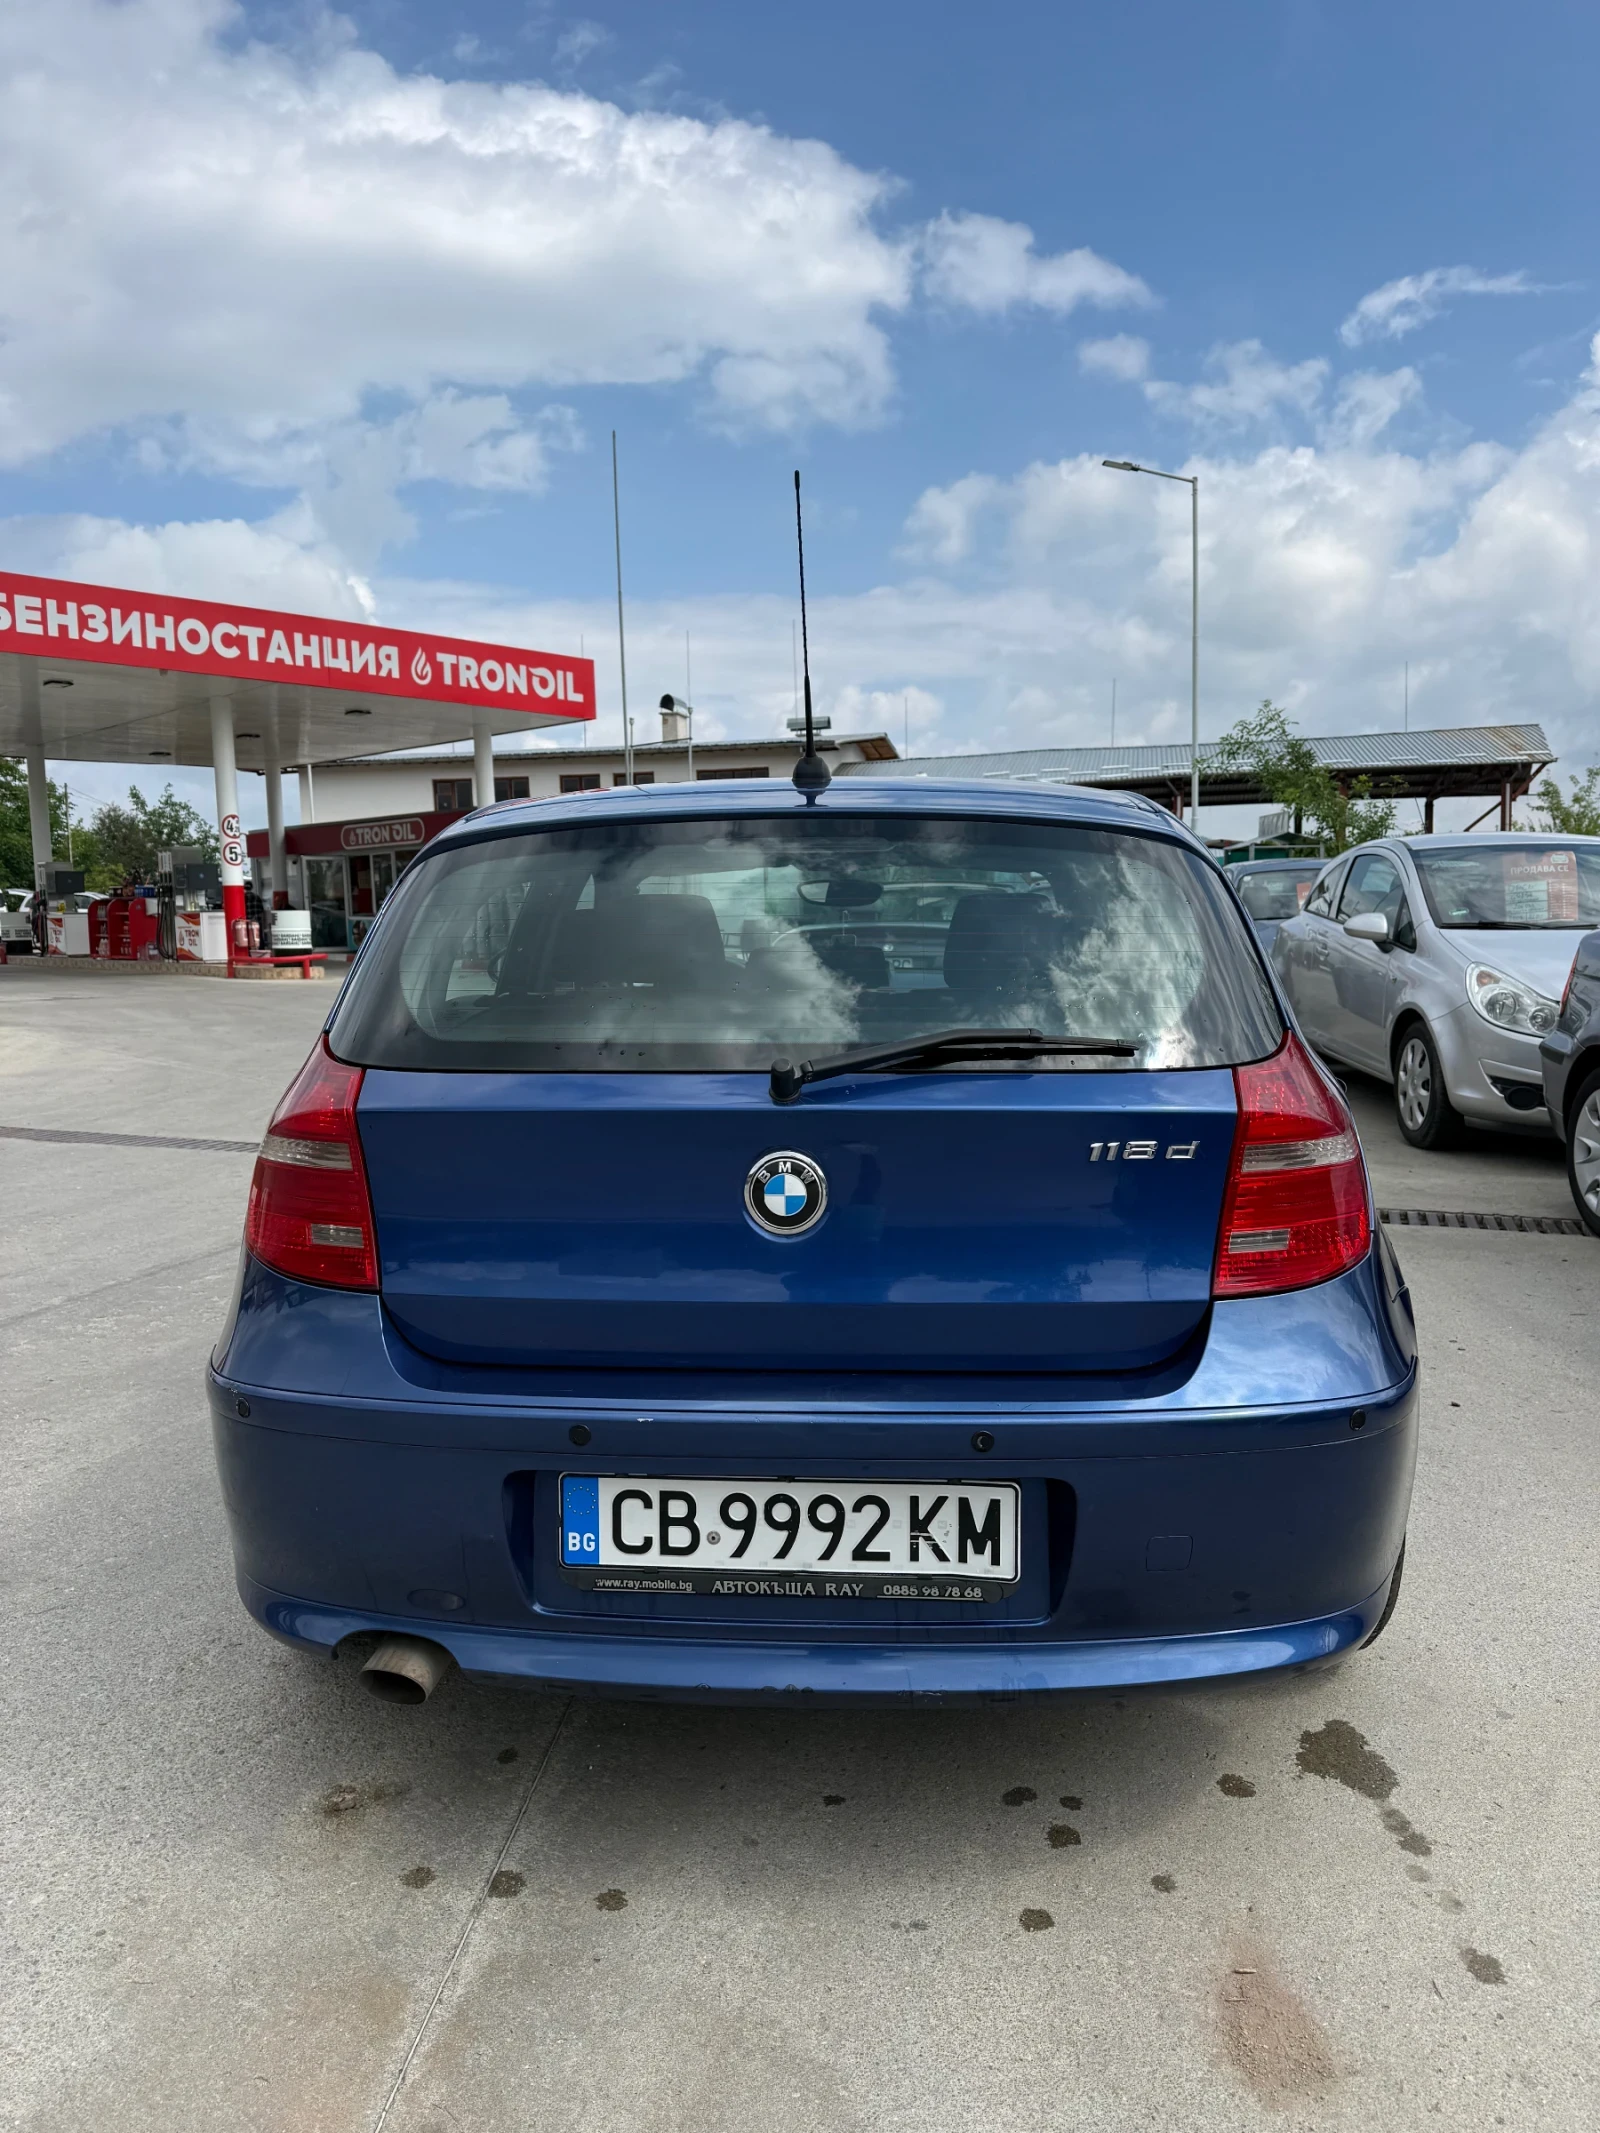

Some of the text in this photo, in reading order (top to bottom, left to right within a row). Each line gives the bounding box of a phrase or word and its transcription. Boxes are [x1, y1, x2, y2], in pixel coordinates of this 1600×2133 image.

[229, 846, 239, 862] 5
[1510, 865, 1569, 875] ПРОДАВА СЕ
[1089, 1140, 1201, 1162] 118 d
[757, 1161, 816, 1184] BMW
[612, 1489, 1001, 1567] CB 9992 KM
[568, 1532, 596, 1552] BG
[595, 1578, 693, 1592] www.ray.mobile.bg
[711, 1580, 864, 1597] АВТОКЪЩА RAY
[883, 1584, 982, 1598] 0885 98 78 68
